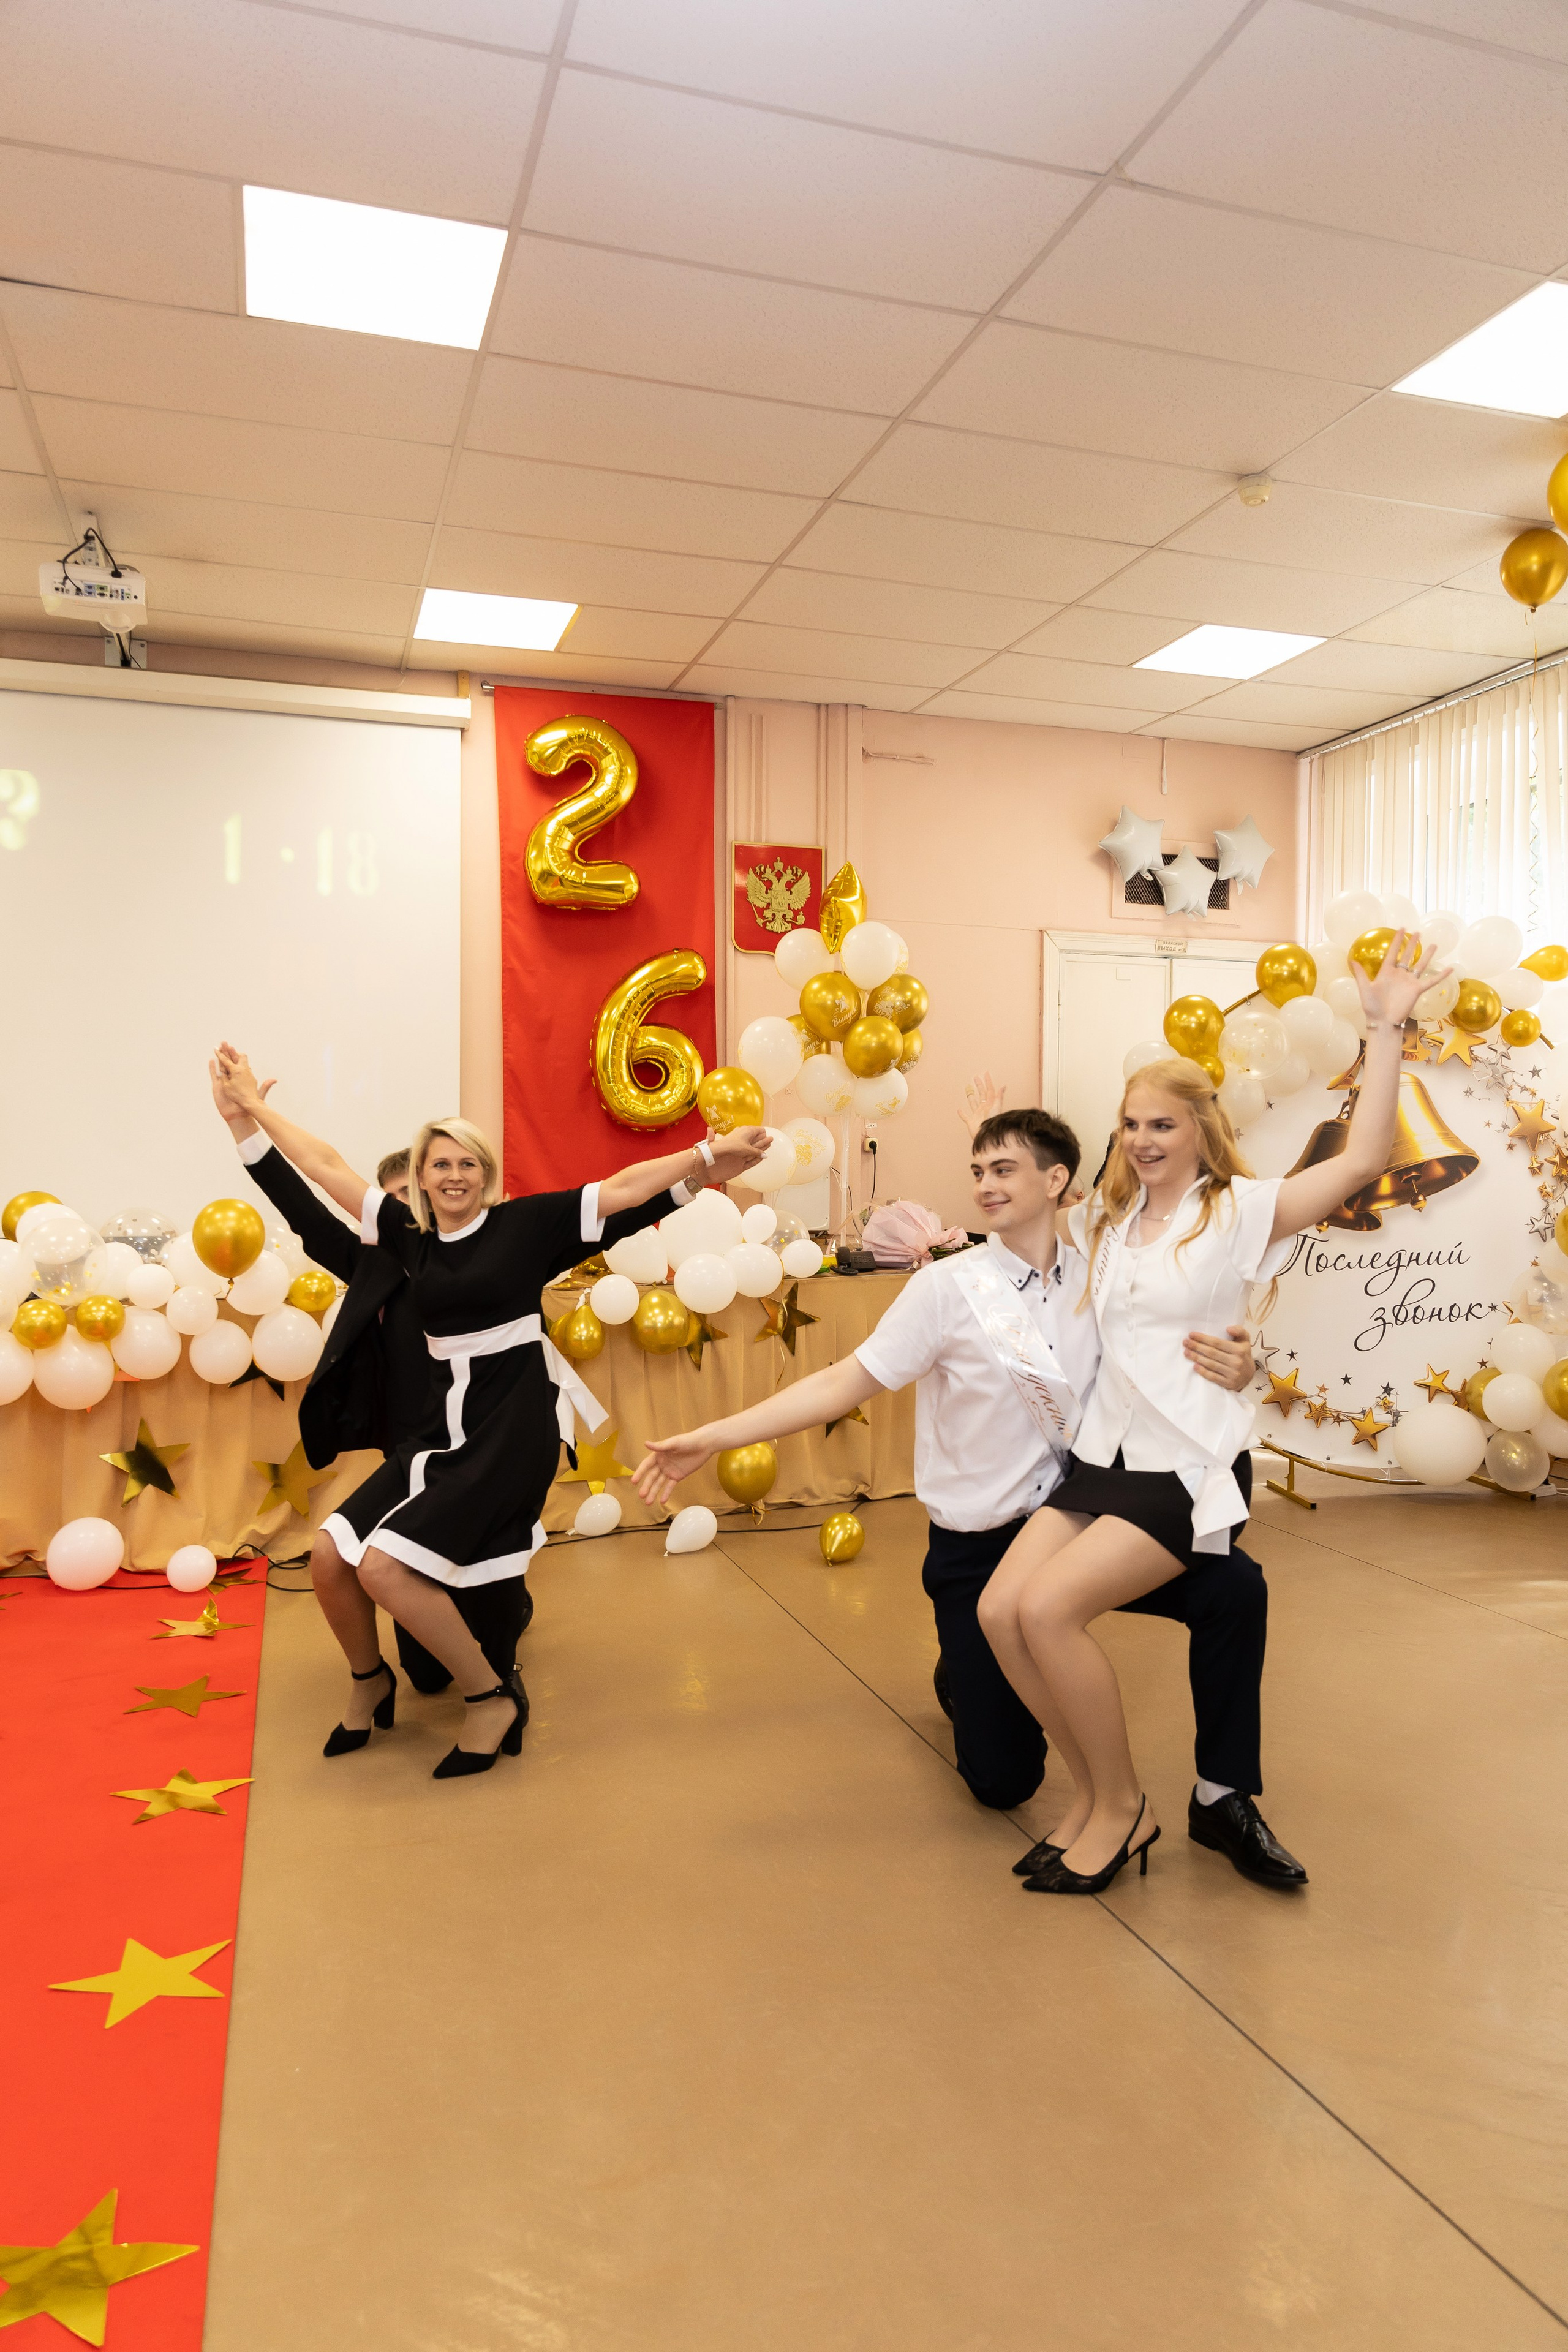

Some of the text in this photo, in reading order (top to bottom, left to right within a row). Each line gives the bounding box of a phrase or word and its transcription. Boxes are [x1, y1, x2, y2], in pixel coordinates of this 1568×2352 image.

[524, 714, 640, 910] 2
[589, 948, 707, 1131] 6
[1275, 1232, 1471, 1297] Последний
[1354, 1278, 1490, 1352] звонок
